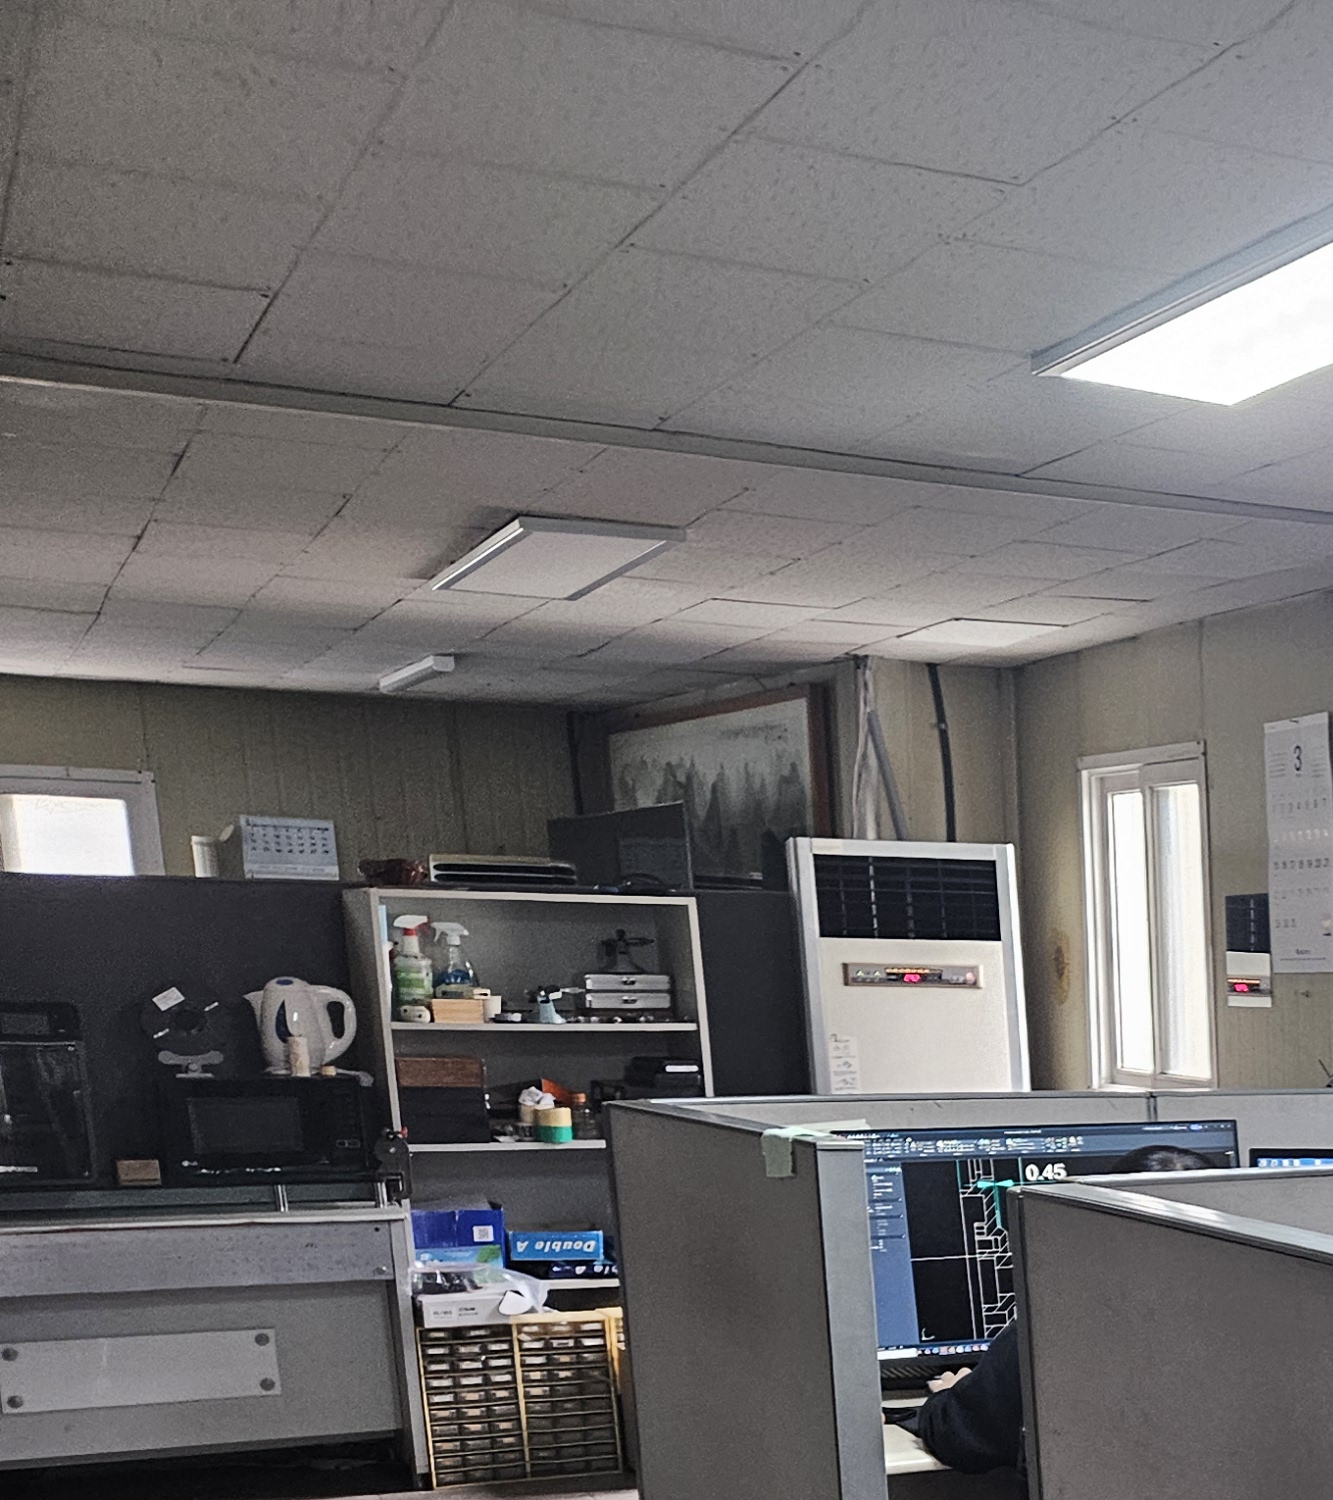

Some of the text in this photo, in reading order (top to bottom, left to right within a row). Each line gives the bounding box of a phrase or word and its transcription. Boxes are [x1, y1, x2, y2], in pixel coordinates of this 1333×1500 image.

[1293, 745, 1302, 772] 3
[1024, 1163, 1068, 1182] 0.45
[516, 1240, 596, 1253] Double A
